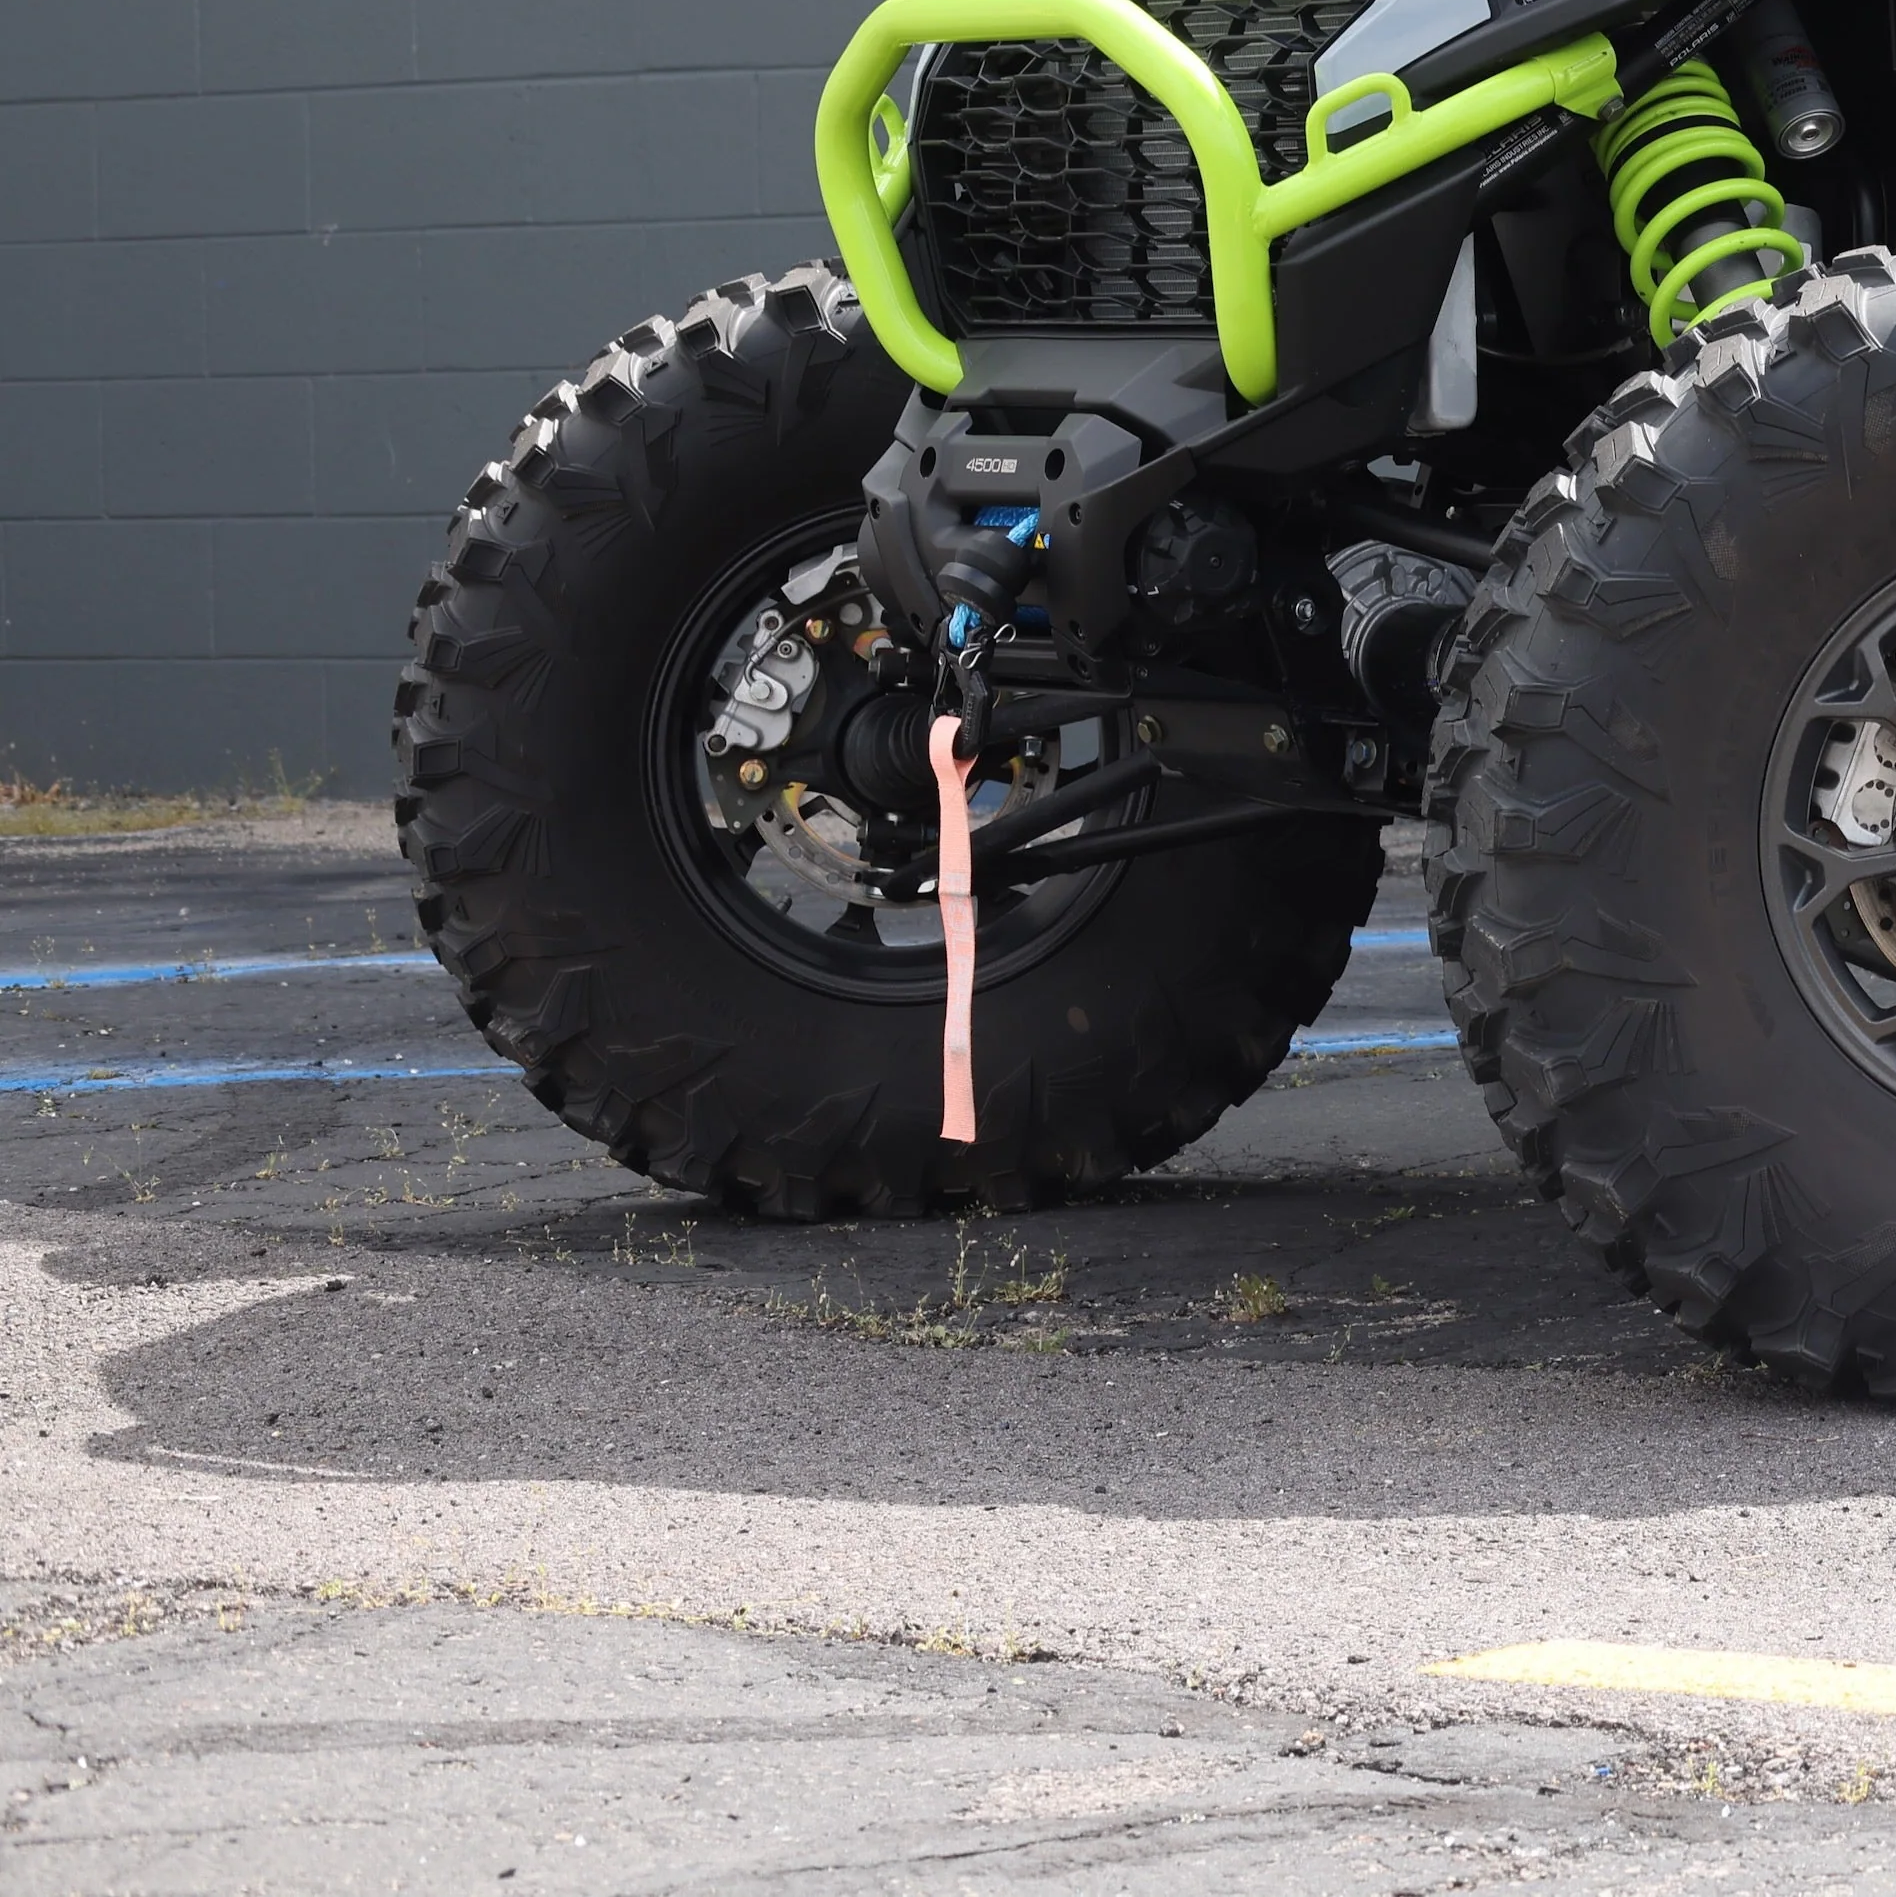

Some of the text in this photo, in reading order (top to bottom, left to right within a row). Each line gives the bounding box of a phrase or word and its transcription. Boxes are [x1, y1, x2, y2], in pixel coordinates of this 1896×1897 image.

[1669, 21, 1720, 67] POLARIS
[1486, 114, 1543, 158] LARIS
[1501, 133, 1539, 165] INDUSTRIES
[966, 457, 1001, 473] 4500
